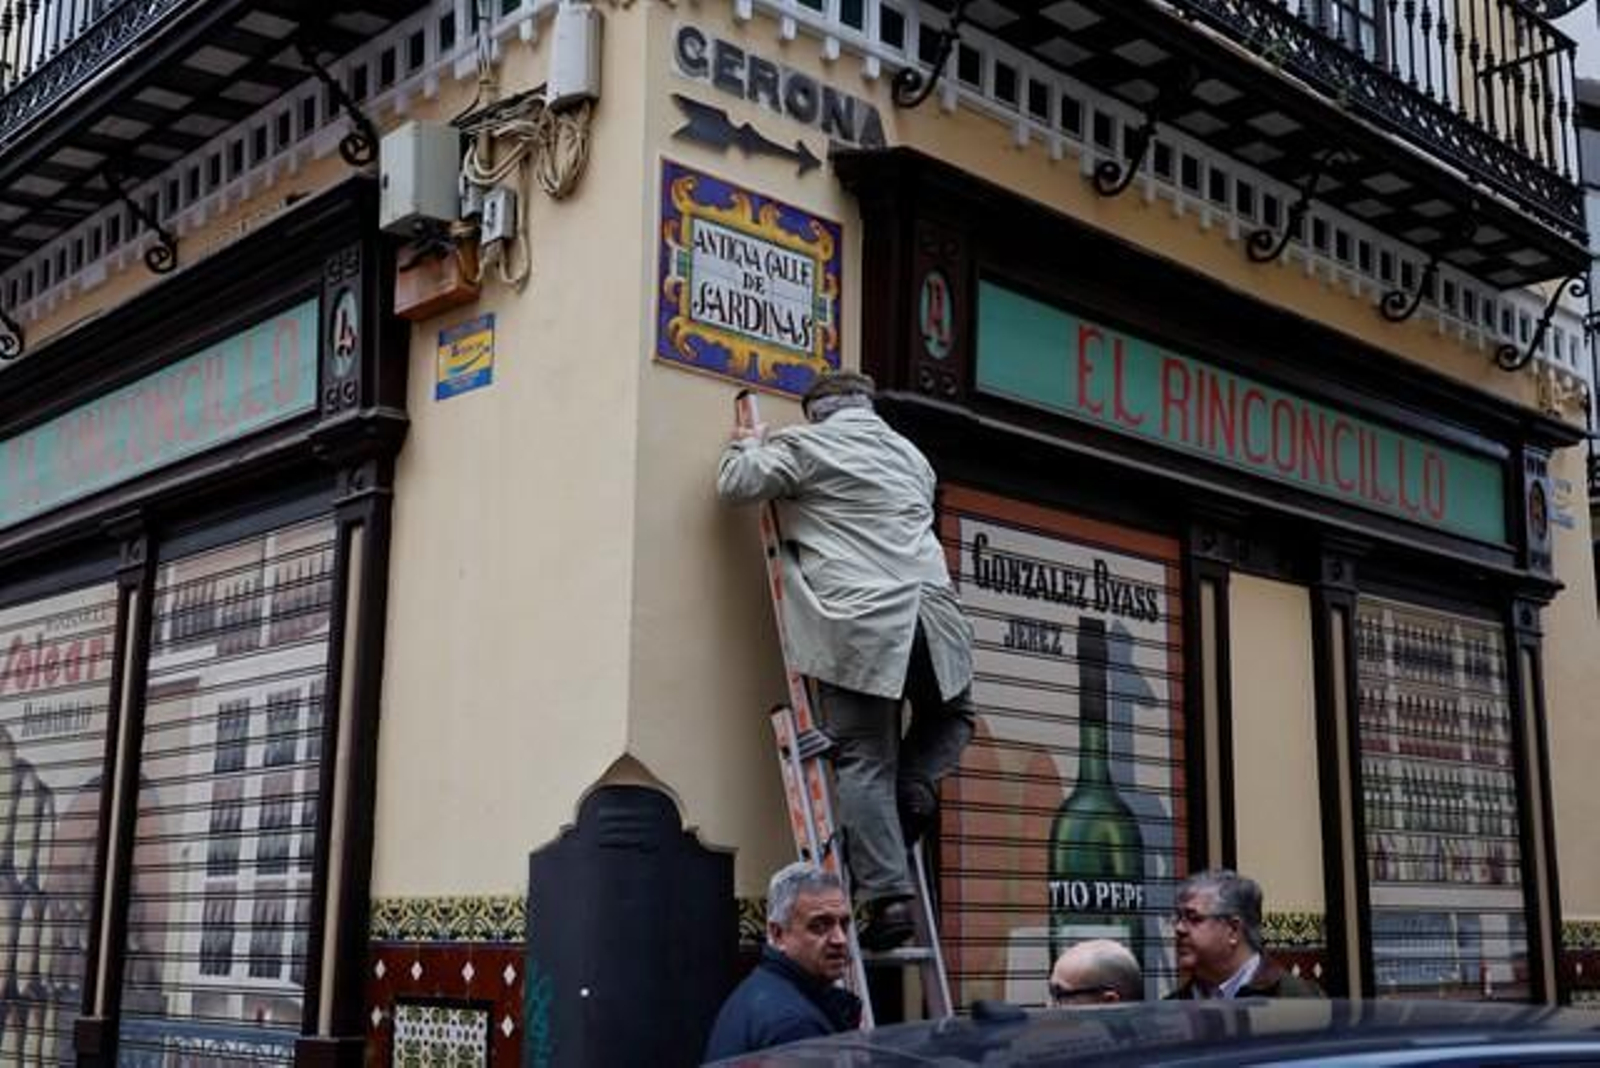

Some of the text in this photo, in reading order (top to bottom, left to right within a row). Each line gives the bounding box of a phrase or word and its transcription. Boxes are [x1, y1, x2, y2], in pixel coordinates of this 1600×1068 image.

[676, 25, 887, 147] GERONA
[743, 272, 766, 295] DE
[765, 249, 811, 287] CALLE
[693, 281, 813, 347] SARDINAS
[1077, 324, 1144, 427] EL
[1160, 357, 1446, 522] RINCONCILLO
[972, 532, 1160, 624] GONZALEZ BYASS
[1003, 619, 1063, 656] JEREZ
[1049, 880, 1090, 910] TIO
